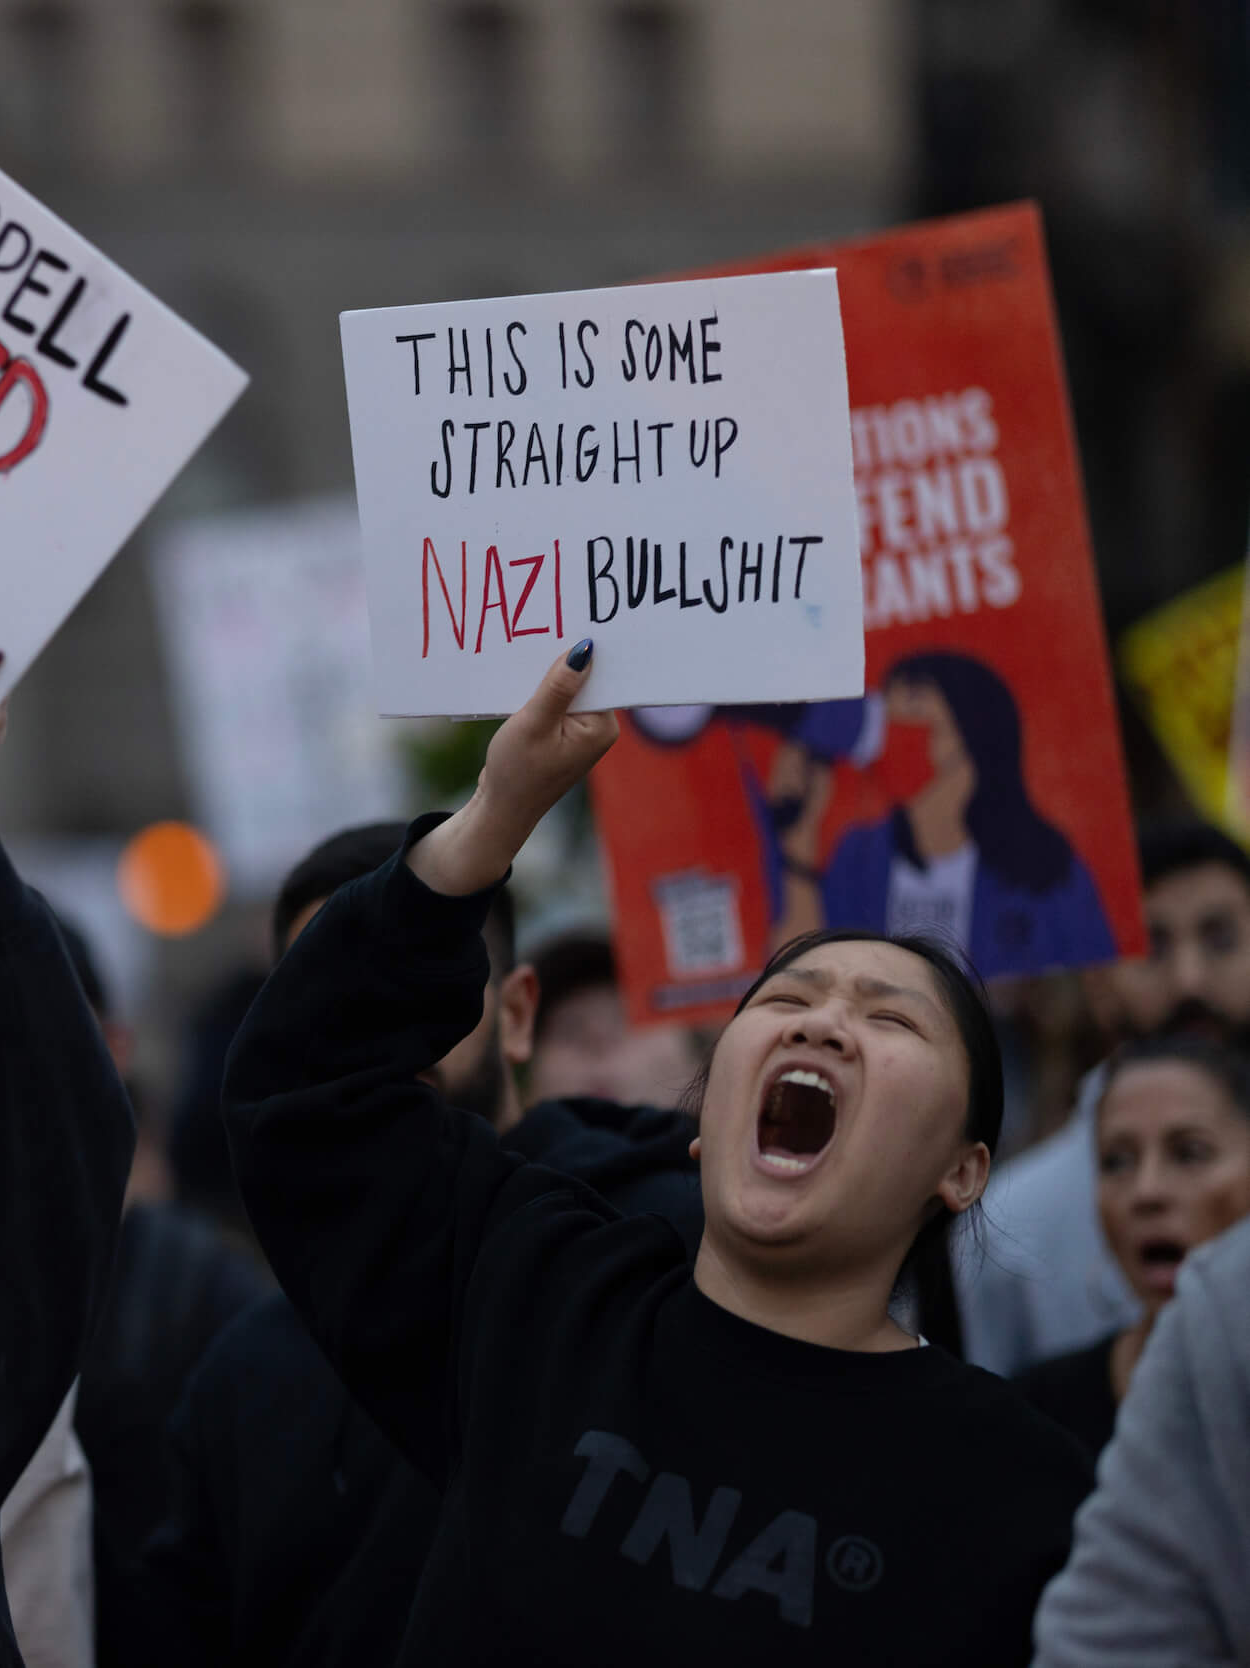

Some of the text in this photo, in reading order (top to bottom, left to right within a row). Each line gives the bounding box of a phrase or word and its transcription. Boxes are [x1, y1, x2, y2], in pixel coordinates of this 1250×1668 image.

[395, 314, 724, 398] THIS IS SOME
[430, 417, 739, 499] STRAIGHT UP
[422, 534, 824, 659] NAZI BULLSHIT
[862, 535, 1022, 632] ANTS
